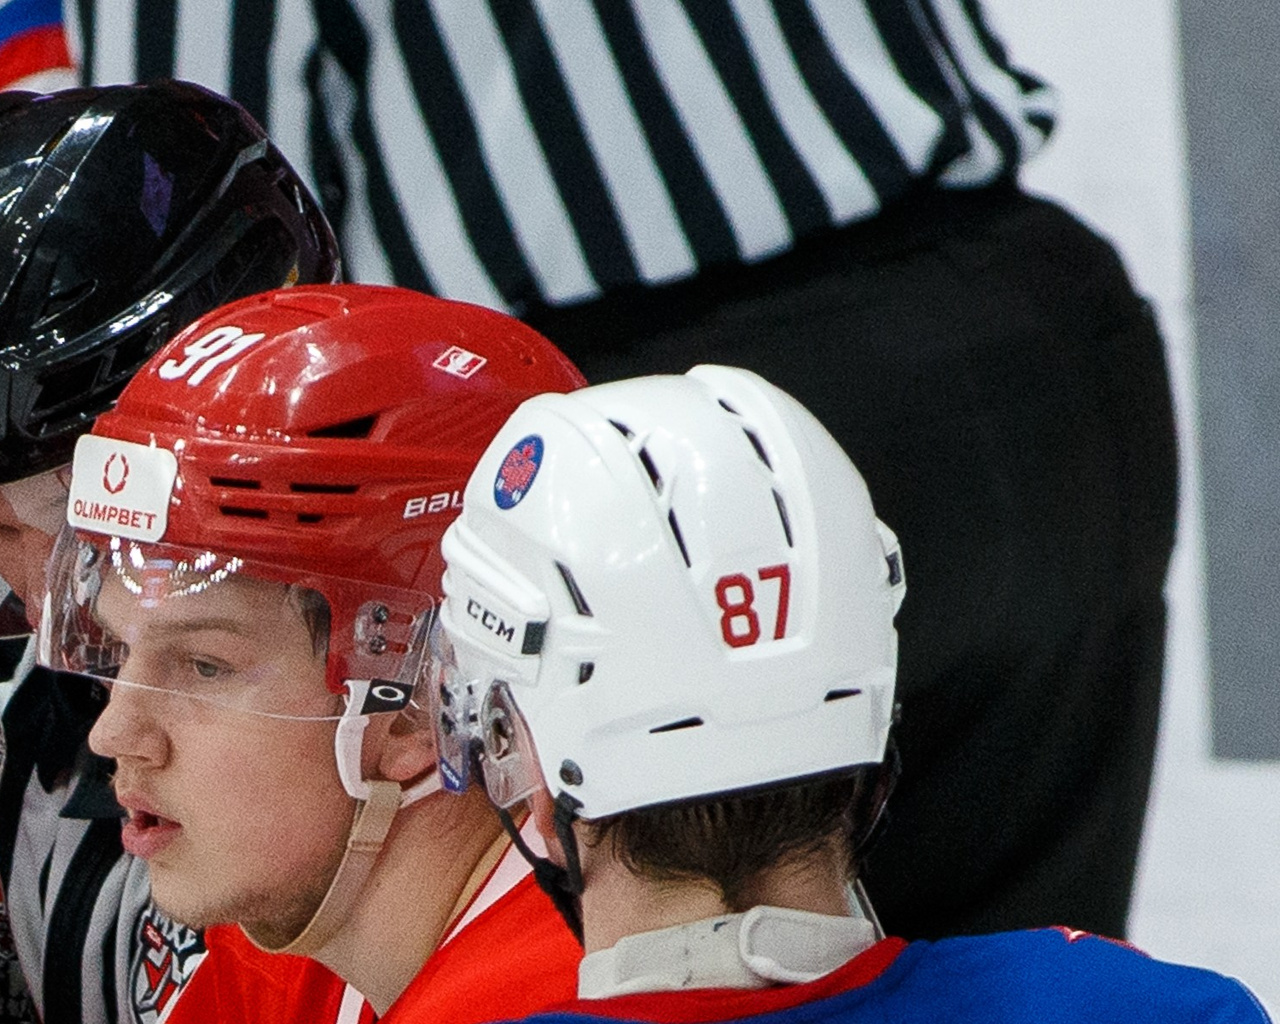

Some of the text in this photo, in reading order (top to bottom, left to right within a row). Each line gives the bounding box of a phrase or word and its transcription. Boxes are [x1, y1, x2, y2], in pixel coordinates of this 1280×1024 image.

[158, 325, 266, 387] 91
[73, 499, 157, 530] OLIMPBET
[467, 598, 515, 643] CCM
[713, 564, 792, 650] 87
